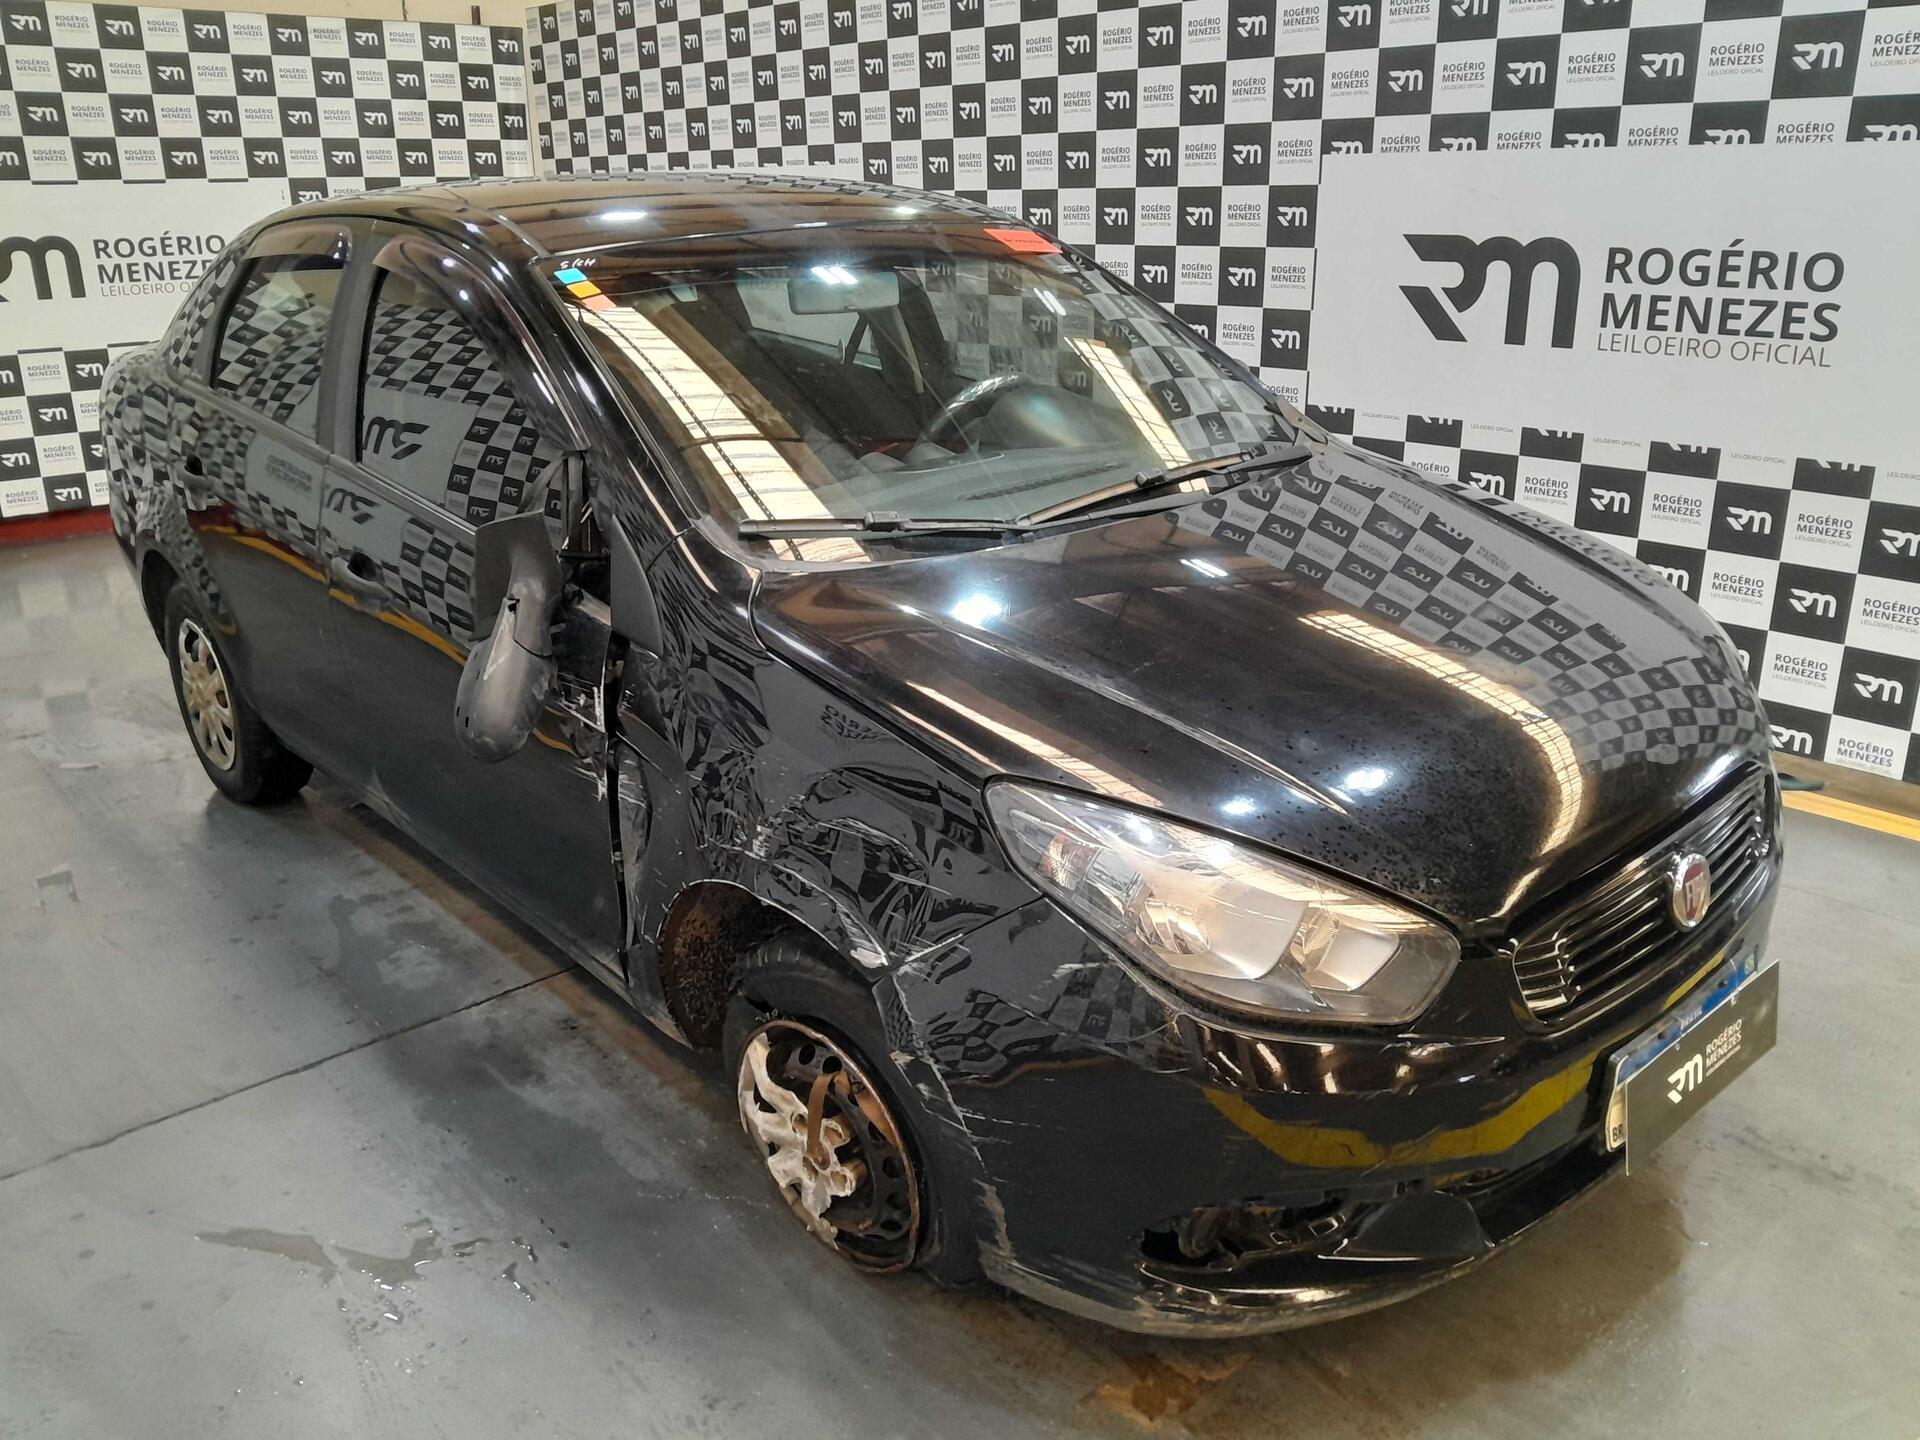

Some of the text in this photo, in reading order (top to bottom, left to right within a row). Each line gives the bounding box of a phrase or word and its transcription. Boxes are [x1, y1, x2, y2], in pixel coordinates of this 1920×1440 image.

[1283, 4, 1320, 19] ROGÉRIO
[56, 21, 90, 29] MENEZES
[1188, 15, 1221, 29] ROGÉRIO
[1283, 15, 1320, 27] MENEZES
[1188, 26, 1221, 37] MENEZES
[1026, 44, 1053, 54] MENEZES
[1710, 40, 1765, 59] ROGÉRIO
[1568, 50, 1616, 66] ROGÉRIO
[1709, 54, 1764, 67] MENEZES
[1442, 59, 1485, 73] ROGÉRIO
[1567, 63, 1615, 75] MENEZES
[1232, 75, 1266, 89] ROGÉRIO
[1331, 68, 1369, 83] ROGÉRIO
[1442, 71, 1485, 82] MENEZES
[1232, 86, 1266, 96] MENEZES
[1331, 79, 1369, 89] MENEZES
[1143, 93, 1174, 102] MENEZES
[990, 104, 1016, 112] MENEZES
[1628, 124, 1679, 140] ROGÉRIO
[1777, 120, 1835, 136] ROGÉRIO
[1277, 137, 1313, 149] ROGÉRIO
[1381, 133, 1421, 147] ROGÉRIO
[1497, 129, 1542, 143] ROGÉRIO
[1627, 137, 1678, 147] MENEZES
[1776, 134, 1834, 144] MENEZES
[1185, 141, 1217, 154] ROGÉRIO
[1277, 148, 1313, 157] MENEZES
[1380, 145, 1420, 154] MENEZES
[1496, 141, 1541, 150] MENEZES
[1101, 155, 1131, 163] MENEZES
[1185, 152, 1217, 160] MENEZES
[1227, 202, 1261, 214] ROGÉRIO
[1227, 212, 1261, 220] MENEZES
[92, 231, 226, 259] ROGÉRIO
[1181, 261, 1213, 271] ROGÉRIO
[1271, 263, 1306, 276] ROGÉRIO
[1604, 239, 1845, 293] ROGÉRIO
[1181, 272, 1213, 280] MENEZES
[1271, 274, 1306, 283] MENEZES
[101, 281, 175, 297] LEILOEIRO
[1599, 292, 1842, 343] MENEZES
[1222, 321, 1255, 333] ROGÉRIO
[1222, 331, 1255, 341] MENEZES
[1597, 332, 1832, 369] LEILOEIRO OFICIAL
[28, 369, 61, 377] MENEZES
[44, 450, 76, 458] MENEZES
[1525, 474, 1569, 490] ROGÉRIO
[1524, 485, 1568, 499] MENEZES
[6, 495, 39, 504] MENEZES
[1653, 491, 1702, 508] ROGÉRIO
[1652, 503, 1701, 518] MENEZES
[1798, 511, 1853, 529] ROGÉRIO
[1796, 523, 1852, 539] MENEZES
[1713, 570, 1764, 588] ROGÉRIO
[1712, 581, 1763, 598] MENEZES
[1864, 595, 1920, 615] ROGÉRIO
[1862, 608, 1920, 626] MENEZES
[1775, 652, 1828, 674] ROGÉRIO
[1773, 663, 1827, 681] MENEZES
[1839, 735, 1894, 758] ROGÉRIO
[1837, 747, 1892, 767] MENEZES
[1705, 1018, 1743, 1056] ROGÉRIO
[1705, 1031, 1742, 1068] MENEZES
